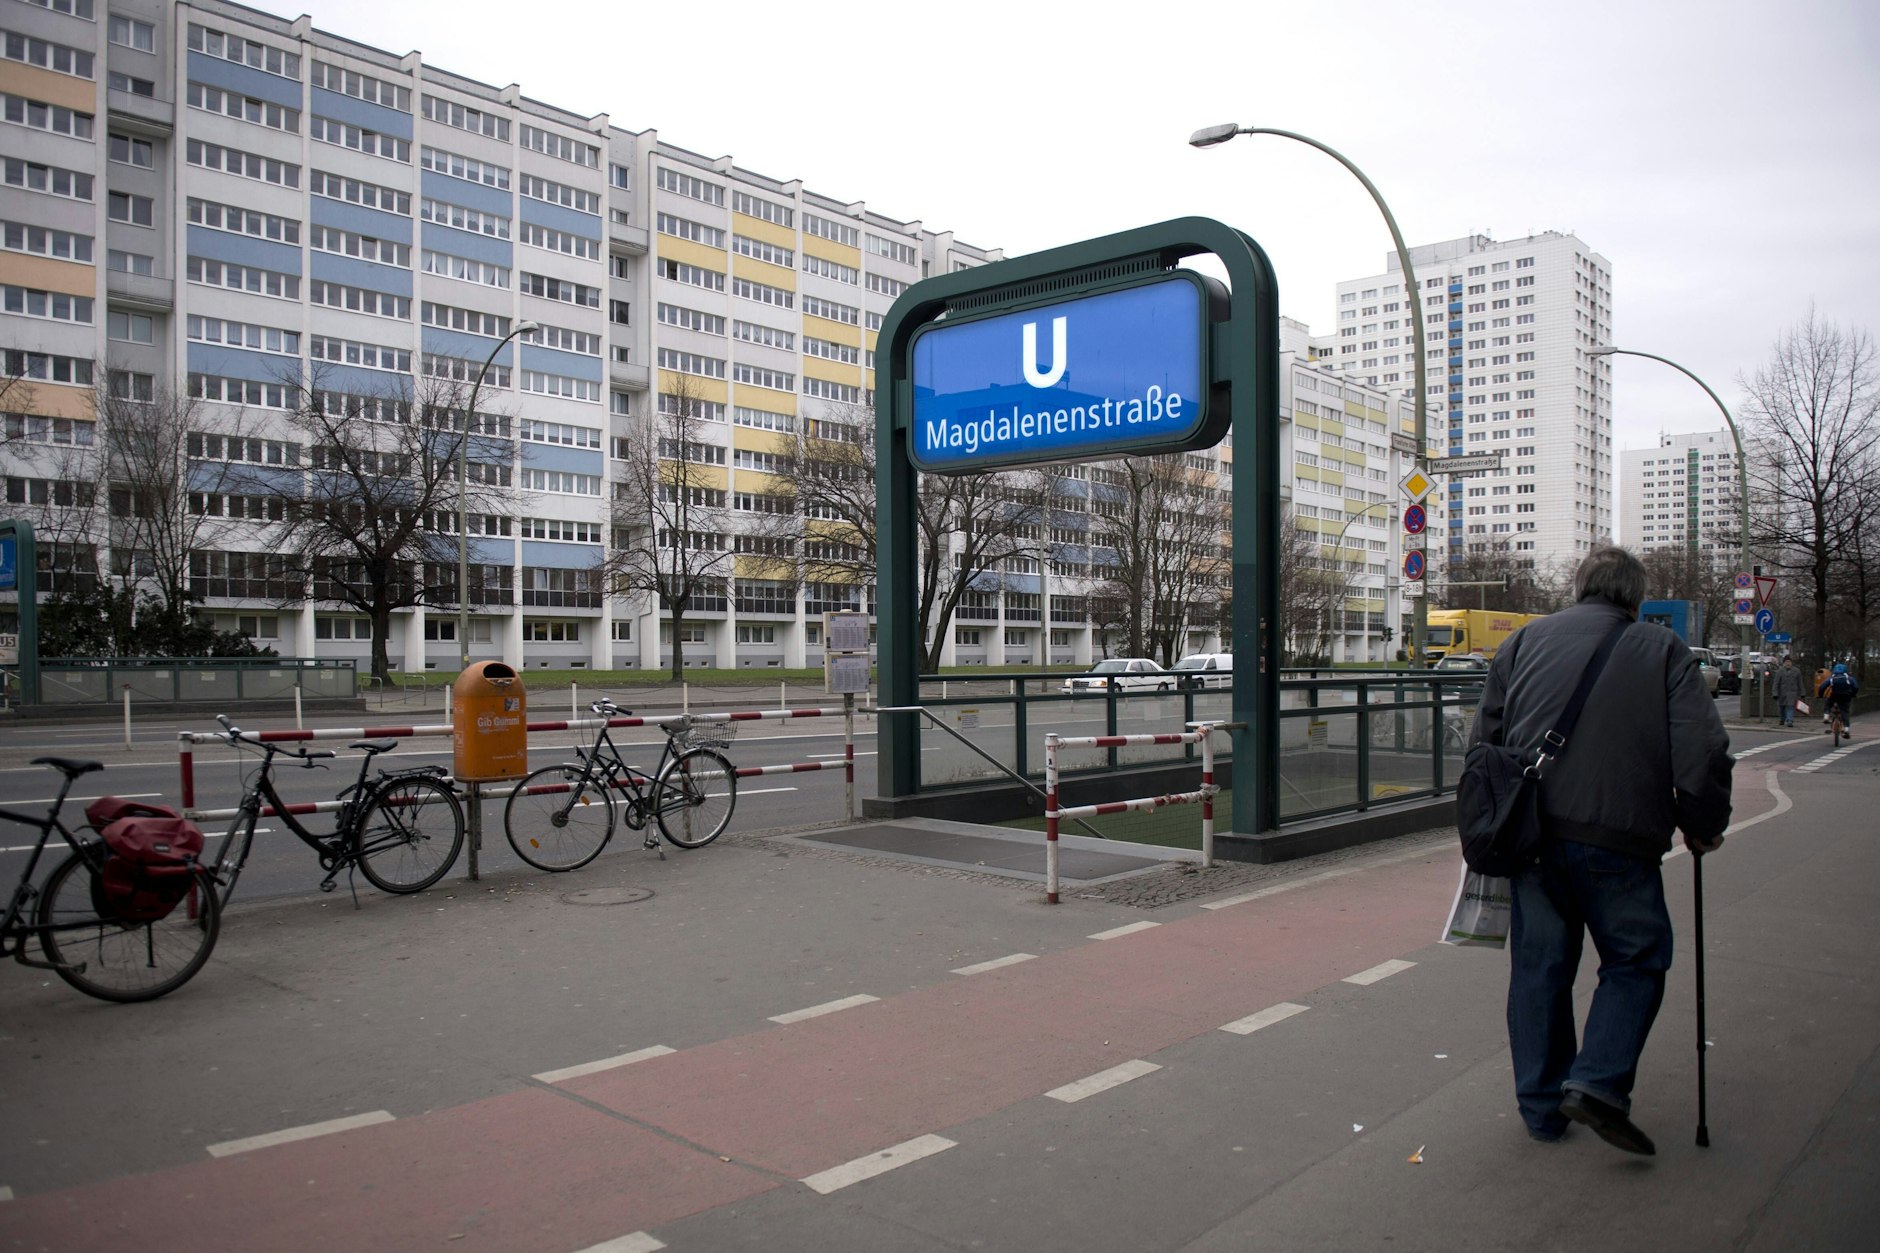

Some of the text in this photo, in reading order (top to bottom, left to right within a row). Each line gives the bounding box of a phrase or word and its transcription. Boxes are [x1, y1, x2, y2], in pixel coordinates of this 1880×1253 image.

[1022, 316, 1067, 389] U
[926, 384, 1182, 454] Magdalenenstraße
[1433, 458, 1497, 470] Magdalenenstraße
[0, 637, 14, 646] U5
[478, 716, 519, 727] Gib Gummi
